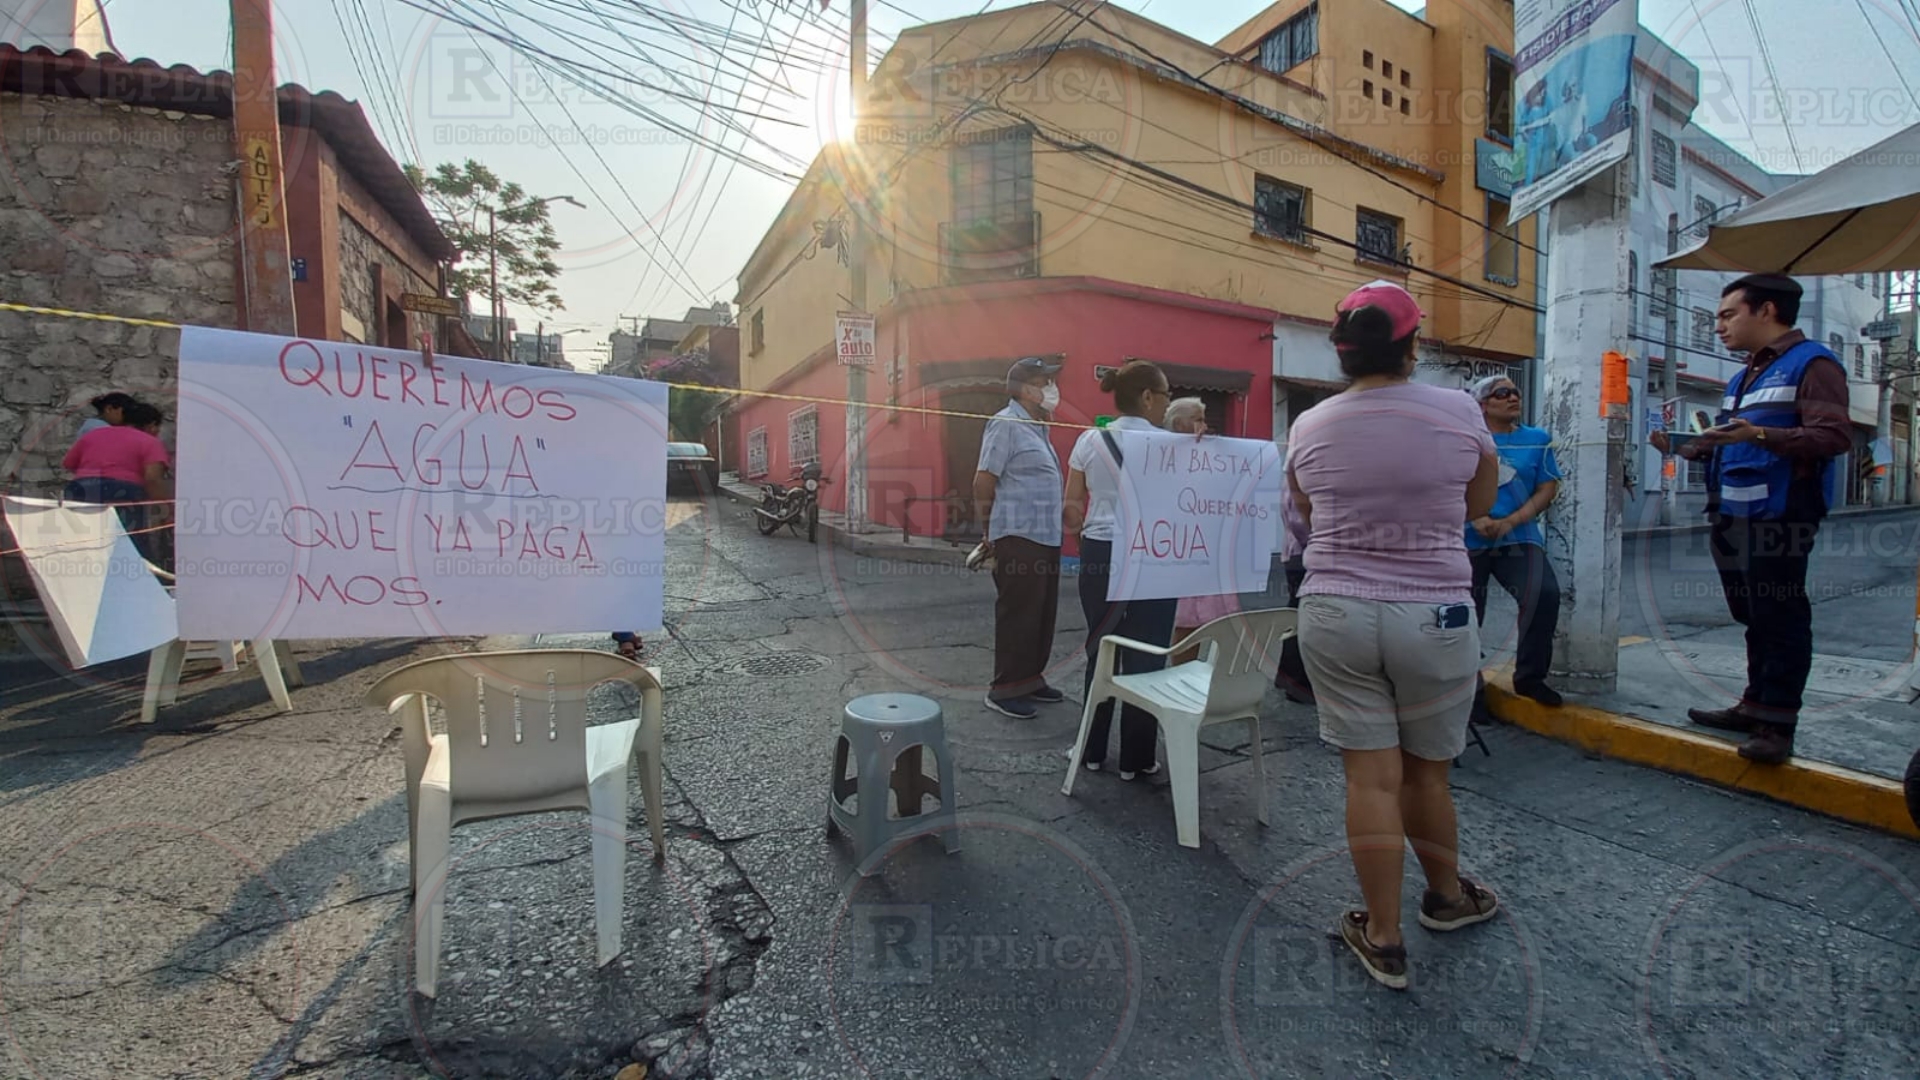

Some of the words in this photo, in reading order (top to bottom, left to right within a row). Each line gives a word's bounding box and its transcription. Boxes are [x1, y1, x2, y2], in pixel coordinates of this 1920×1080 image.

[840, 339, 873, 355] auto
[279, 340, 577, 421] QUEREMOS
[281, 506, 397, 551] QUE
[424, 514, 473, 553] YA
[497, 518, 595, 562] PAGA
[1129, 519, 1210, 560] AGUA
[296, 574, 442, 606] MOS.
